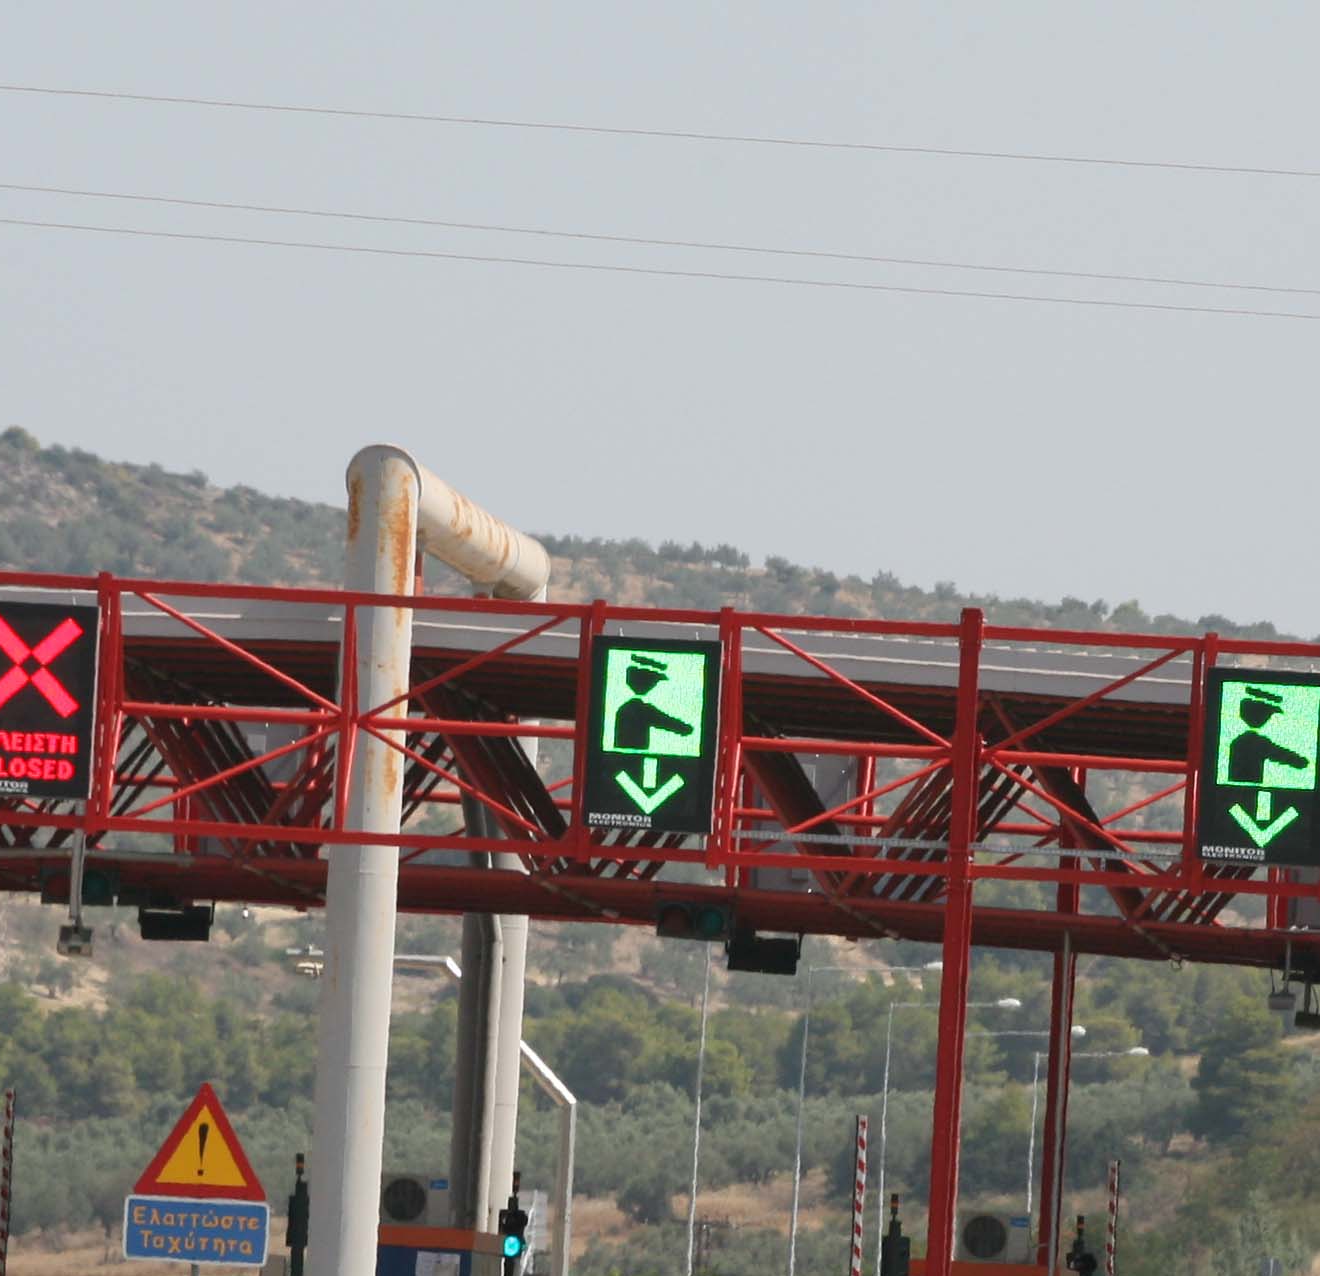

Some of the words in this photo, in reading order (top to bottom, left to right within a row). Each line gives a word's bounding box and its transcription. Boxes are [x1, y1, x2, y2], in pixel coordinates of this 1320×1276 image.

[589, 812, 651, 823] MONITOR
[1202, 845, 1265, 856] MONITOR
[133, 1205, 260, 1231] Ελαττώστε
[140, 1229, 253, 1256] Ταχύτητα
